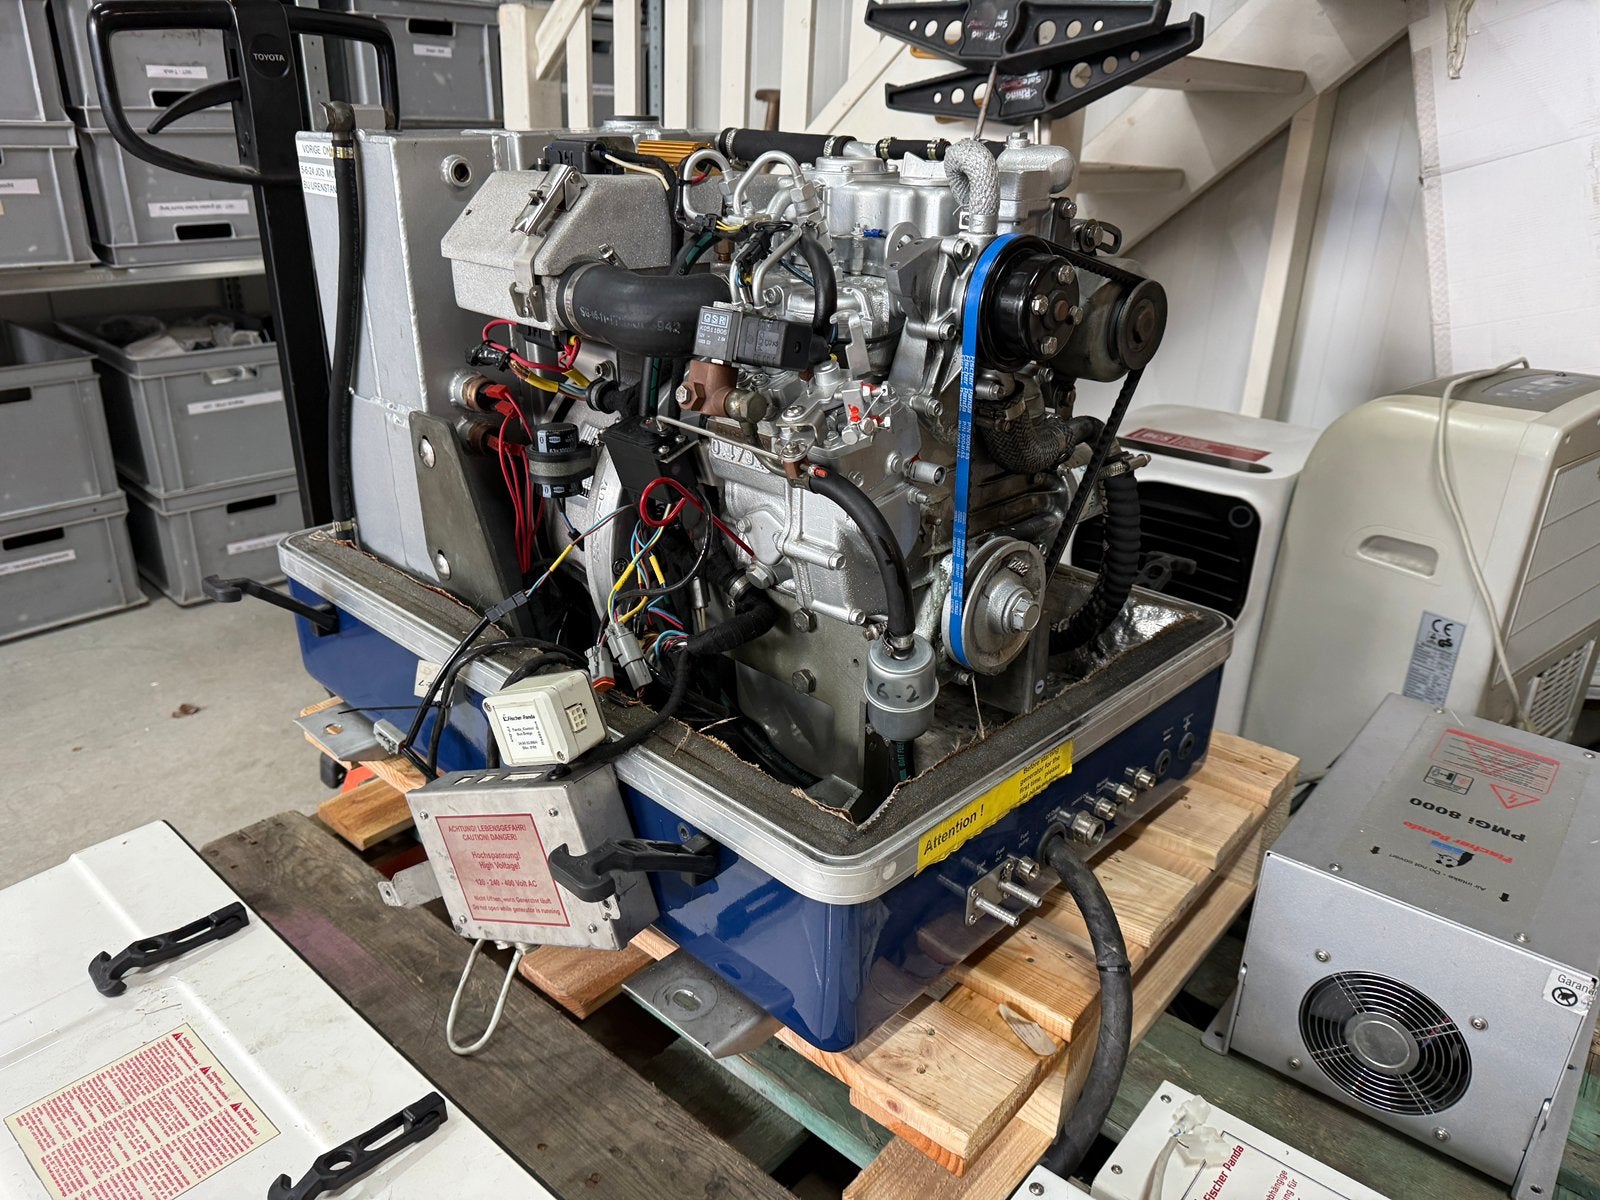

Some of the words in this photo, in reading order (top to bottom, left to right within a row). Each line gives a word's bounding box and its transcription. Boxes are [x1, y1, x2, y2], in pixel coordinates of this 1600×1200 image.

[253, 53, 285, 62] TOYOTA
[1005, 88, 1031, 100] Rhino
[704, 313, 726, 326] GSR
[656, 321, 680, 334] 942
[1019, 767, 1044, 786] generator
[1044, 762, 1052, 770] for
[1052, 755, 1060, 765] the
[1023, 760, 1040, 774] Before
[1019, 783, 1030, 794] first
[1044, 764, 1060, 778] please
[1409, 797, 1462, 820] 8000
[924, 811, 976, 855] Attention
[1403, 821, 1451, 842] Panda
[1468, 816, 1527, 843] PMGi
[472, 851, 521, 860] Hochspannung!
[1454, 838, 1513, 864] Fischer
[479, 862, 494, 870] High
[496, 862, 521, 871] Voltage!
[1415, 862, 1428, 871] not
[1448, 874, 1473, 887] intake
[1202, 1170, 1229, 1200] Fischer
[1222, 1144, 1244, 1172] Panda
[1288, 1178, 1298, 1191] für
